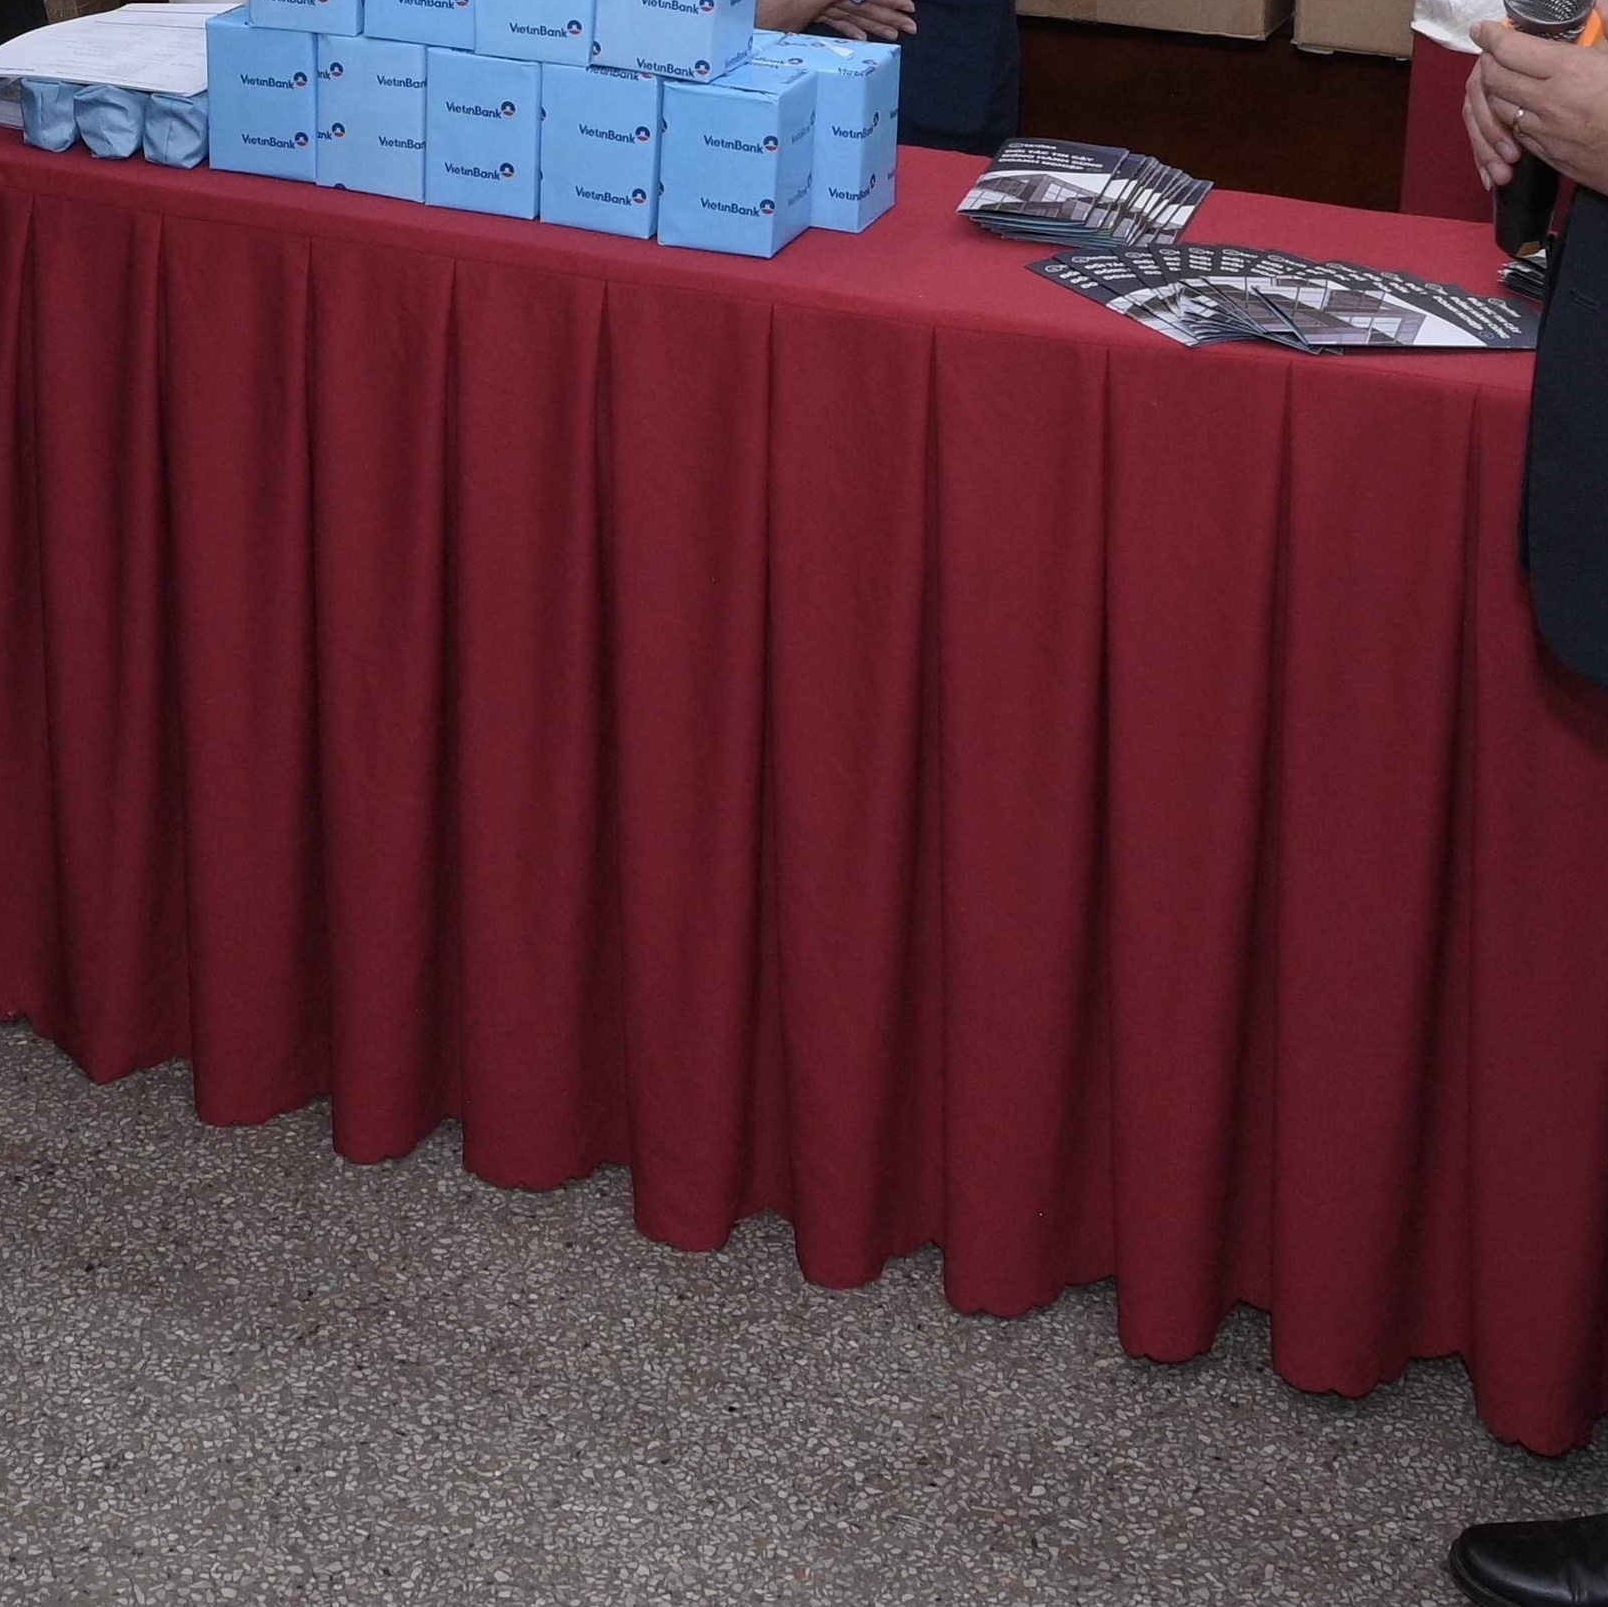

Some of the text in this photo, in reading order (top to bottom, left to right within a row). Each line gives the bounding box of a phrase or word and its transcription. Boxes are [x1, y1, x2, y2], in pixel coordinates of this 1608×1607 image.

[509, 21, 569, 38] VietinBank
[636, 57, 695, 78] VietinBank
[240, 73, 296, 90] VietinBank
[445, 101, 503, 120] VietinBank
[242, 133, 297, 150] VietinBank
[579, 123, 637, 144] VietinBank
[704, 134, 765, 154] VietinBank
[444, 161, 502, 180] VietinBank
[575, 185, 633, 207] VietinBank
[700, 196, 761, 218] VietinBank
